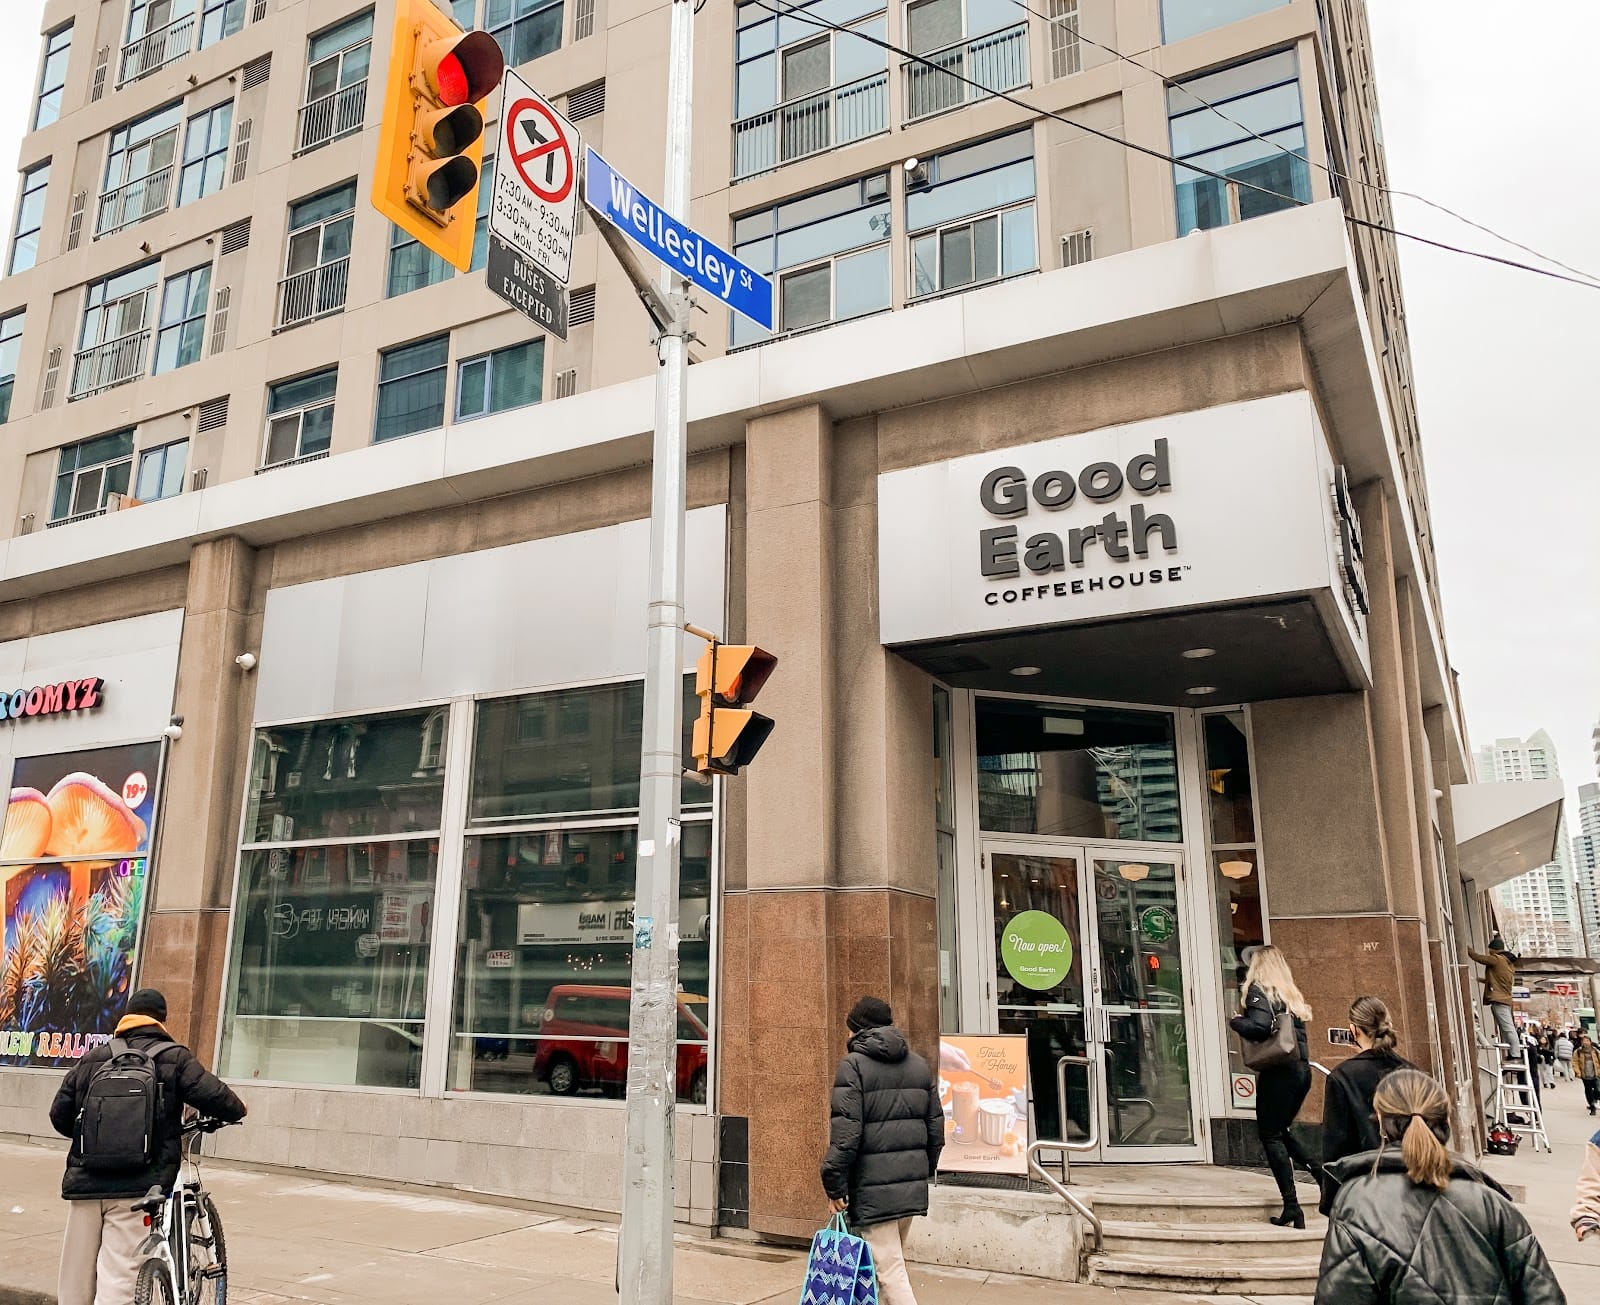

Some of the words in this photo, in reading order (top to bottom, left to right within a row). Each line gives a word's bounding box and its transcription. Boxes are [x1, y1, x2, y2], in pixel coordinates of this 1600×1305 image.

[513, 230, 532, 250] MON
[537, 249, 550, 266] FRI
[608, 173, 735, 301] Wellesley
[739, 269, 753, 291] St
[513, 259, 545, 295] BUSES
[503, 278, 553, 324] EXCEPTED
[980, 438, 1172, 516] Good
[980, 504, 1177, 577] Earth
[126, 783, 145, 799] 19+
[1009, 933, 1036, 953] Now
[1037, 939, 1067, 957] open!
[979, 1046, 1007, 1058] Touch
[988, 1058, 1018, 1073] Honey
